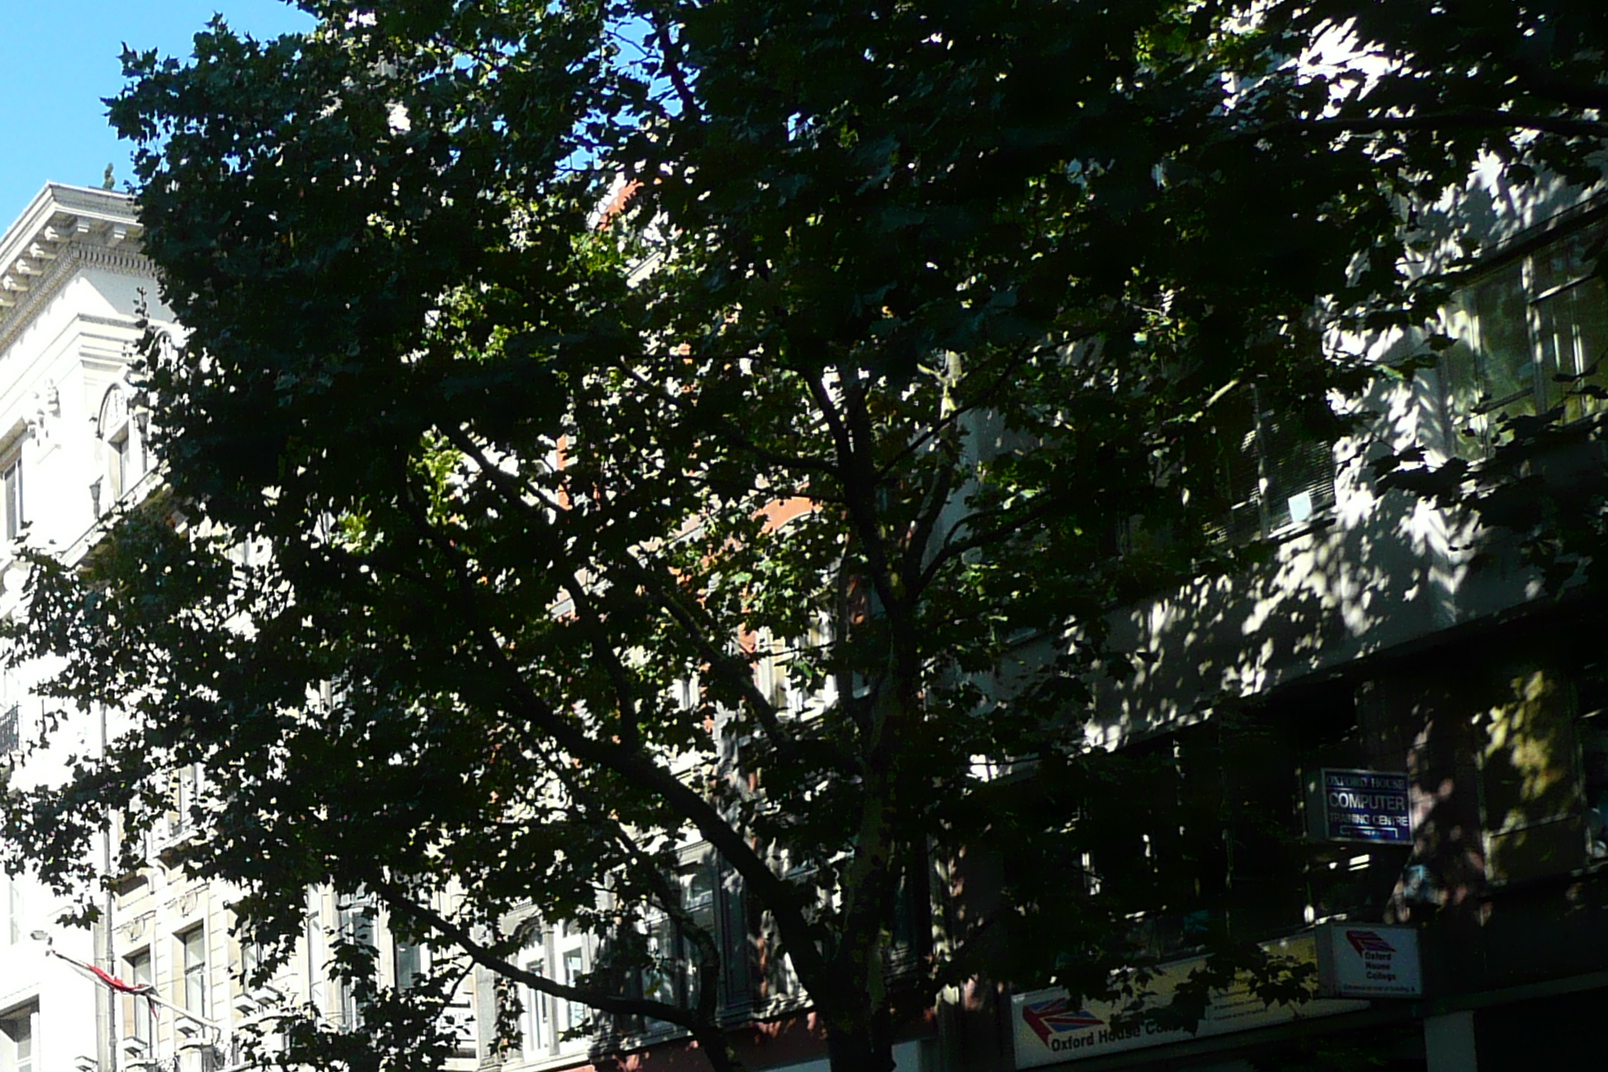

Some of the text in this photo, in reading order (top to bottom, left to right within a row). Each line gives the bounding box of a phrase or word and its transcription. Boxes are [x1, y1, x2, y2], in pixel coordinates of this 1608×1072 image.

[1371, 777, 1405, 789] HOUSE
[1329, 791, 1406, 811] COMPUTER
[1329, 812, 1409, 827] TRAINING CENTRE
[1051, 1031, 1094, 1052] Oxford
[1099, 1024, 1141, 1044] House
